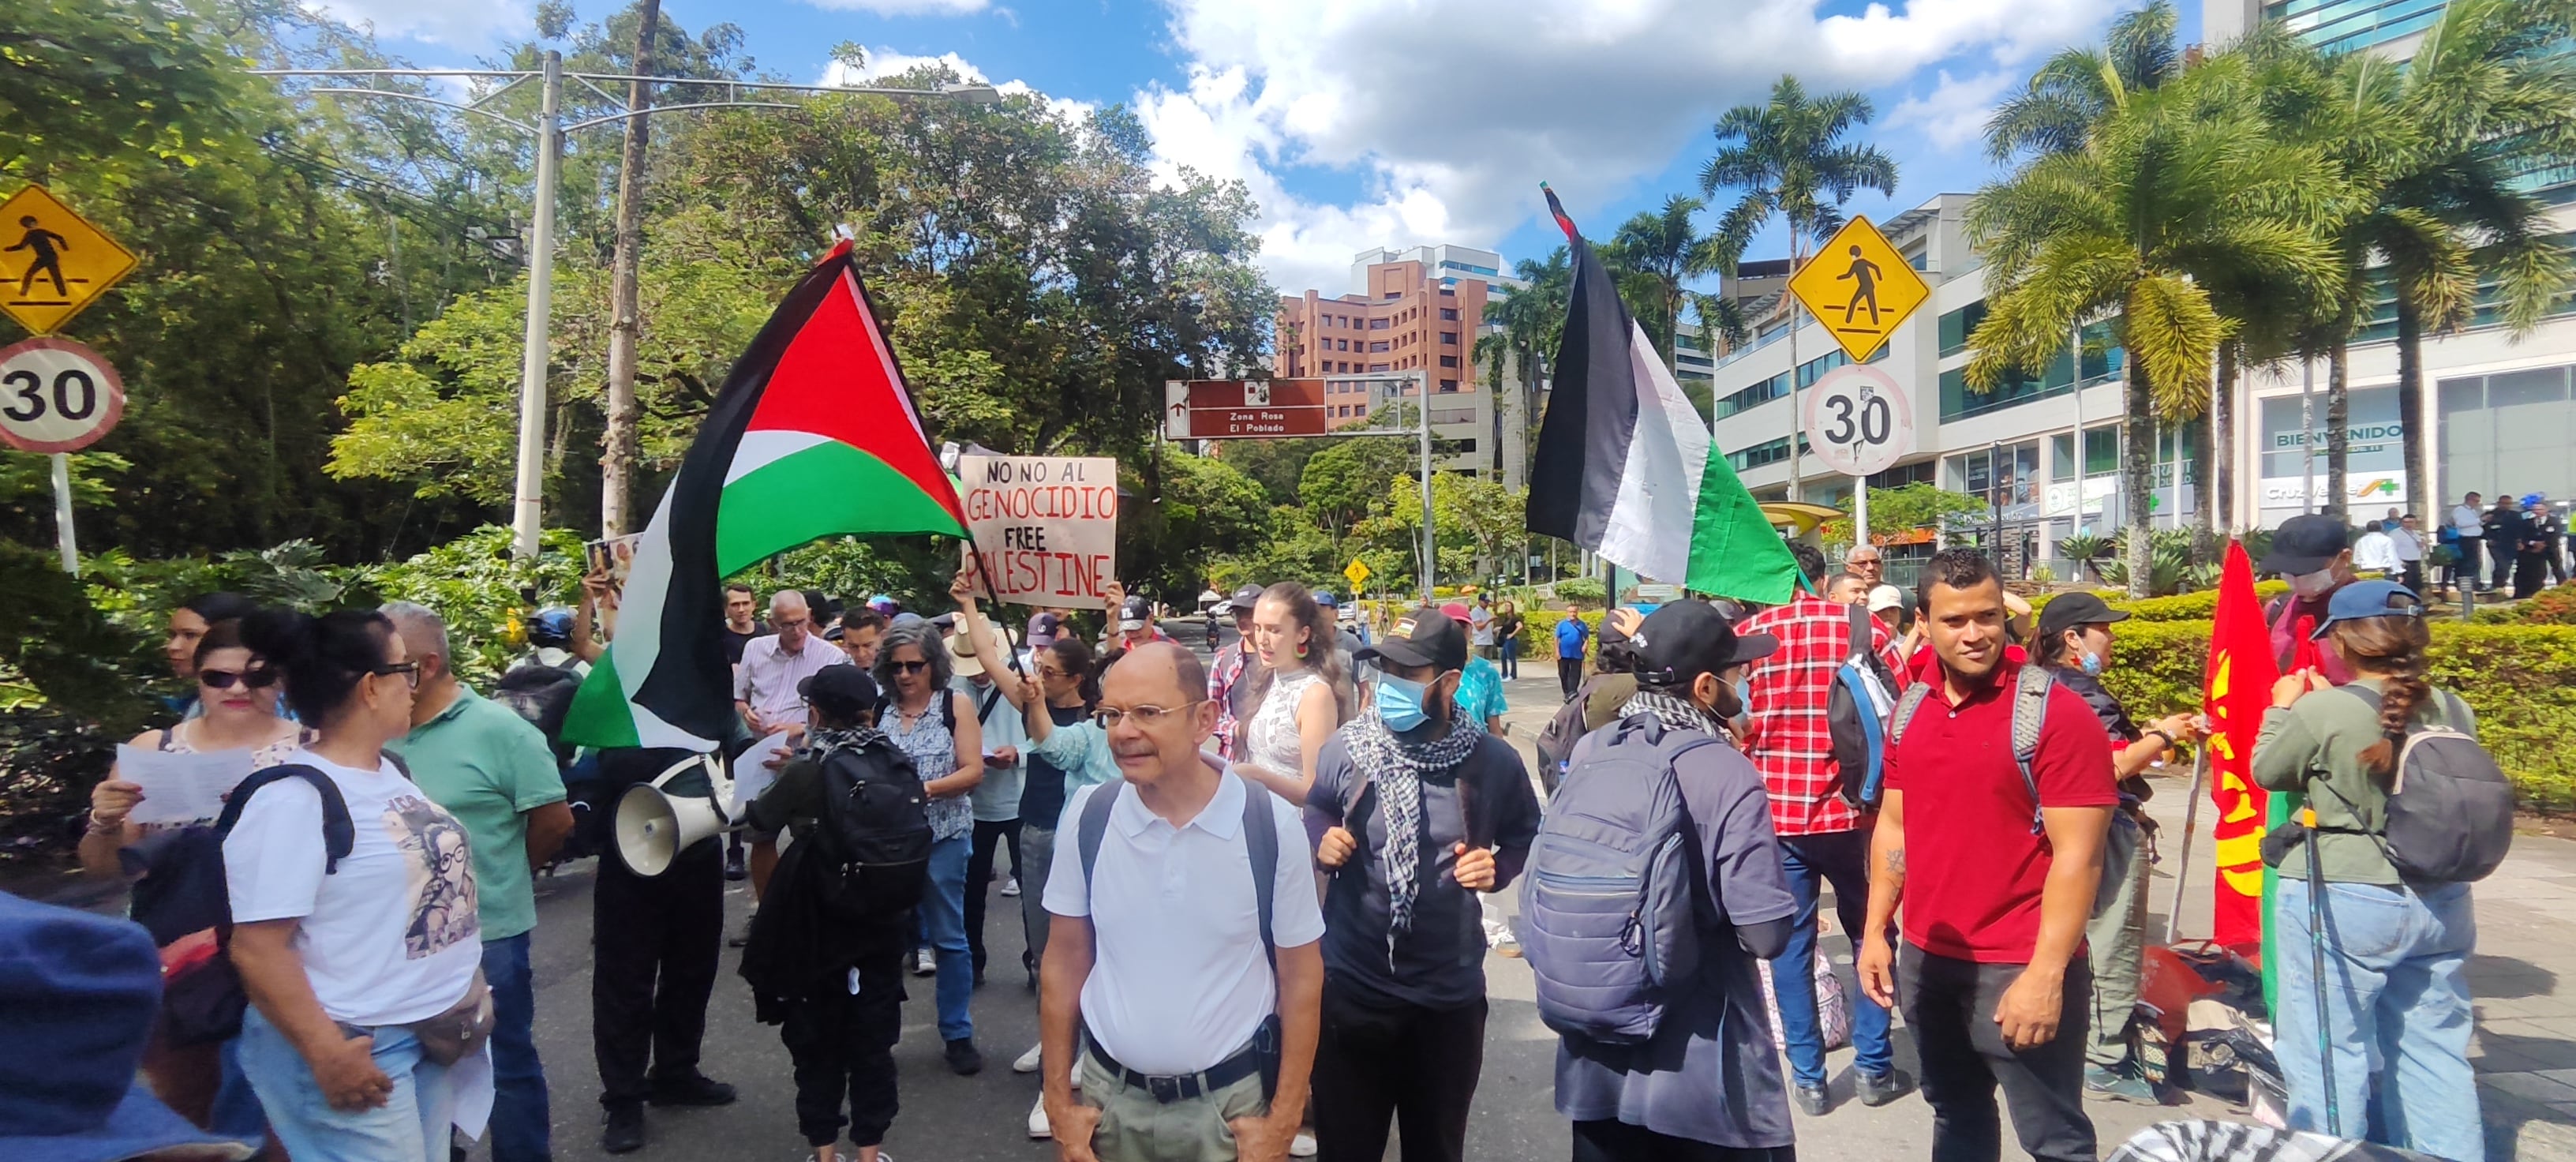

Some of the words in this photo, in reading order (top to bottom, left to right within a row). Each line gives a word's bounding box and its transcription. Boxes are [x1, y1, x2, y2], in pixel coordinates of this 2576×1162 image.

[2, 369, 96, 422] 30
[1230, 412, 1254, 421] Zona
[1260, 411, 1284, 421] Rosa
[1825, 394, 1891, 445] 30
[1230, 424, 1239, 433] El
[1246, 423, 1284, 433] Poblado
[2277, 425, 2404, 447] BIENNIDO
[987, 461, 1012, 483] NO
[1020, 462, 1047, 482] NO
[1061, 462, 1085, 482] AL
[968, 485, 1116, 521] GENOCIDIO
[1005, 527, 1046, 552] FREE
